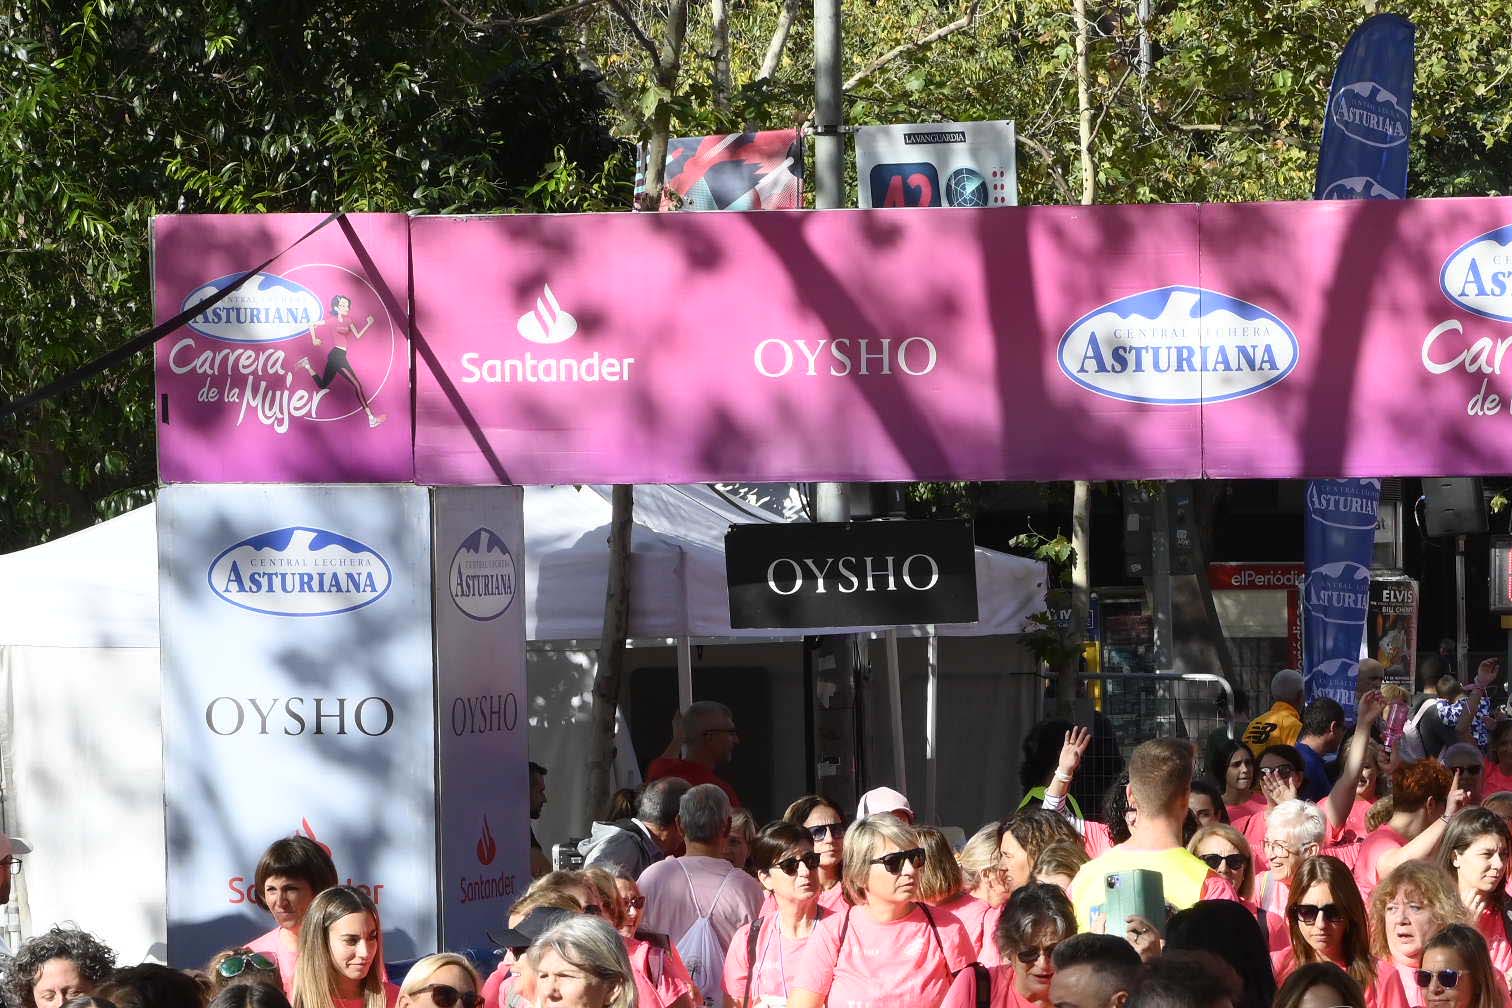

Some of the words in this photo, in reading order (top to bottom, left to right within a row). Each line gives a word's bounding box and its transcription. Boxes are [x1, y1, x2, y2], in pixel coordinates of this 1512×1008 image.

[1077, 331, 1280, 374] ASTURIANA
[1114, 328, 1187, 340] CENTRAL
[168, 338, 286, 376] Carrera
[461, 352, 635, 382] Santander
[754, 337, 937, 378] OYSHO
[198, 378, 219, 403] de
[224, 377, 240, 403] la
[237, 372, 329, 434] Mujer
[1468, 379, 1501, 416] de
[1312, 486, 1380, 516] ASTURIAN
[222, 560, 378, 594] ASTURIANA
[250, 558, 309, 568] CENTRAL
[313, 557, 372, 567] LECHERA
[454, 562, 513, 599] ASTURIANA
[767, 554, 939, 595] OYSHO
[1382, 589, 1414, 602] ELVIS
[205, 696, 395, 737] OYSHO
[451, 692, 518, 737] OYSHO
[460, 873, 516, 904] Santander
